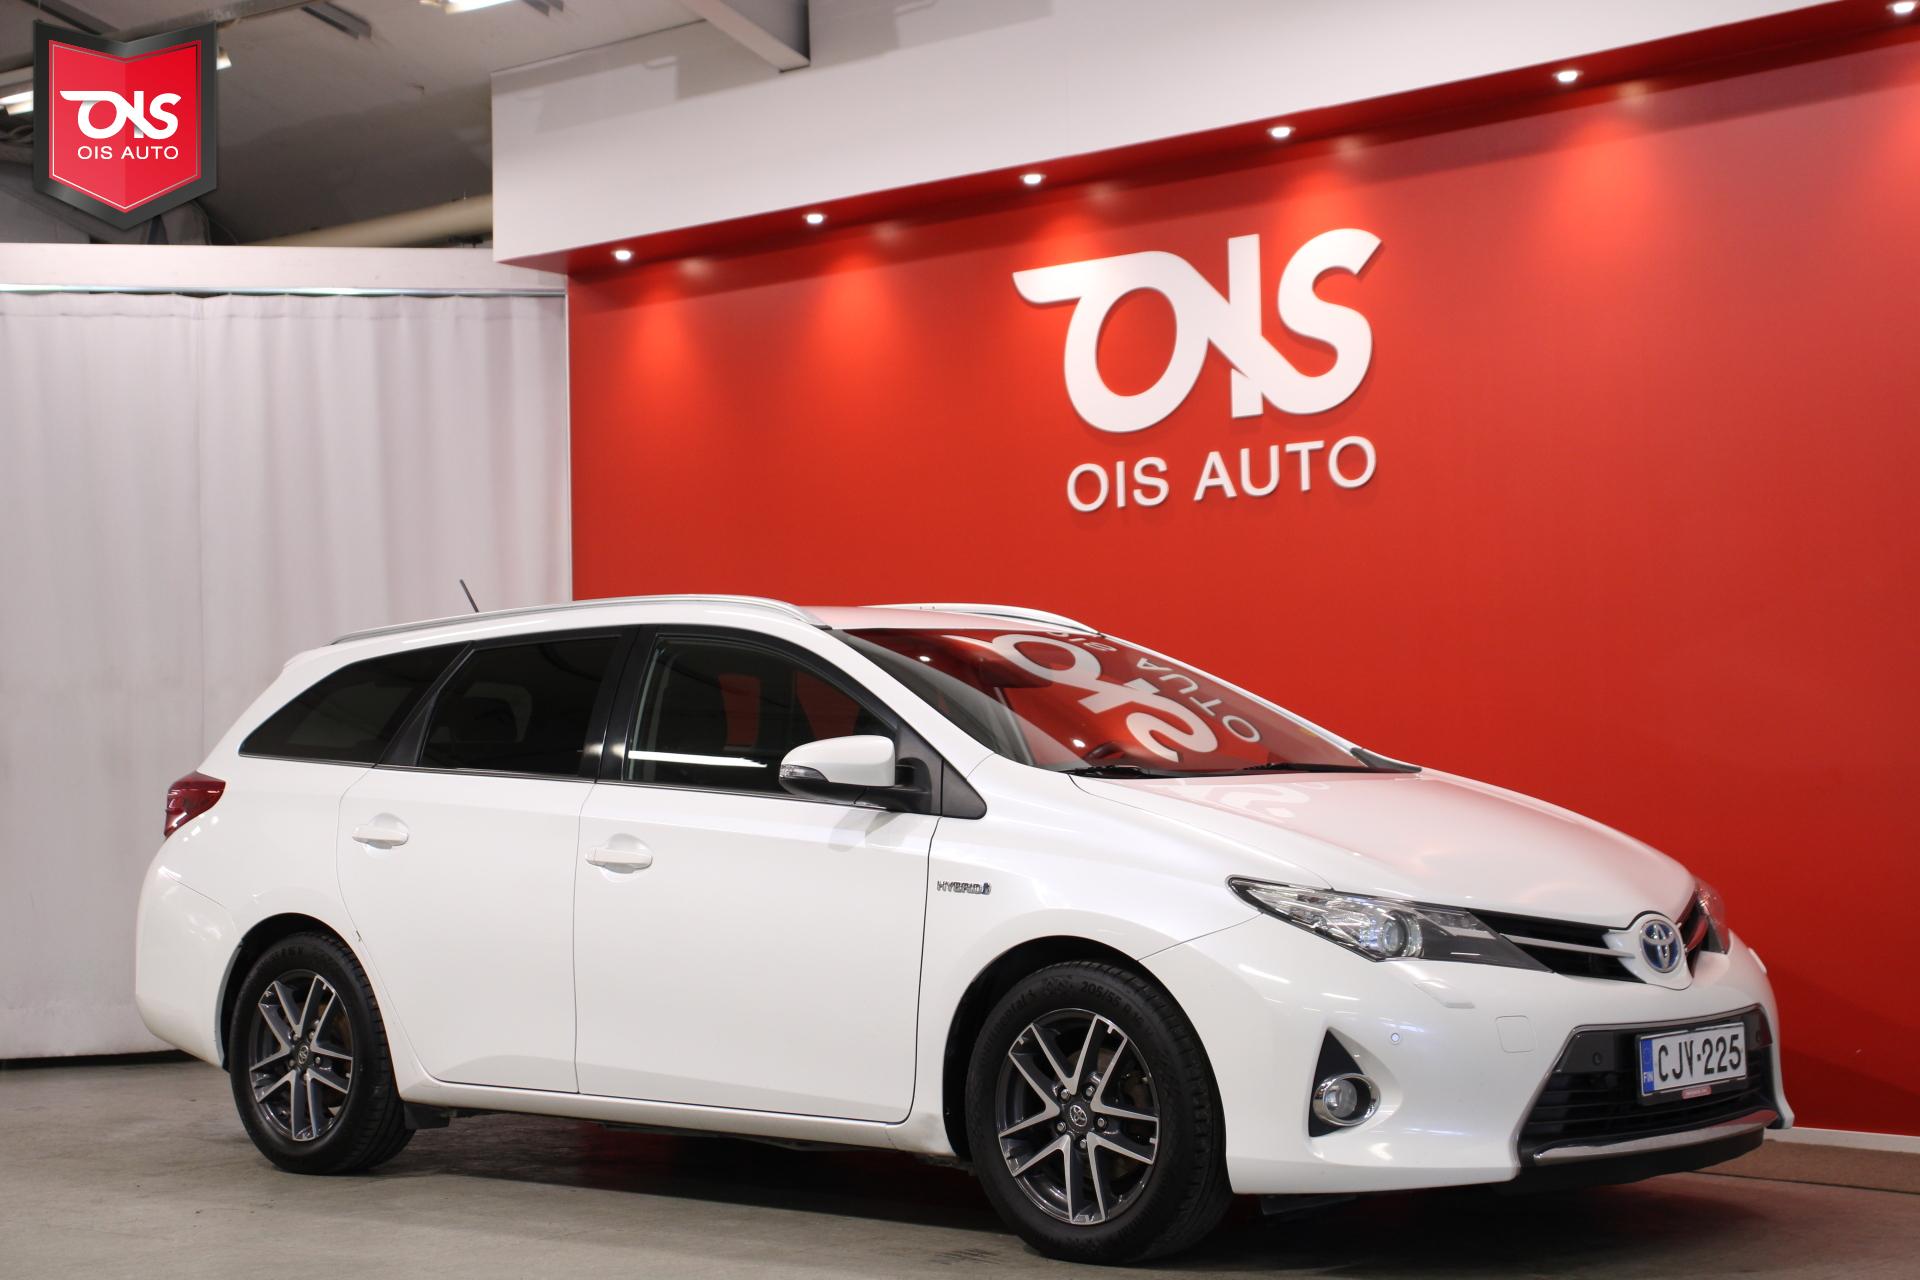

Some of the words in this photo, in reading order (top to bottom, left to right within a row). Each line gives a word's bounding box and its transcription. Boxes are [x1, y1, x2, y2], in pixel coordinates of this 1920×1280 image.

[1067, 457, 1170, 512] OIS
[1194, 436, 1376, 501] AUTO
[937, 880, 981, 894] HYBRID
[1658, 1034, 1741, 1082] CJV-225
